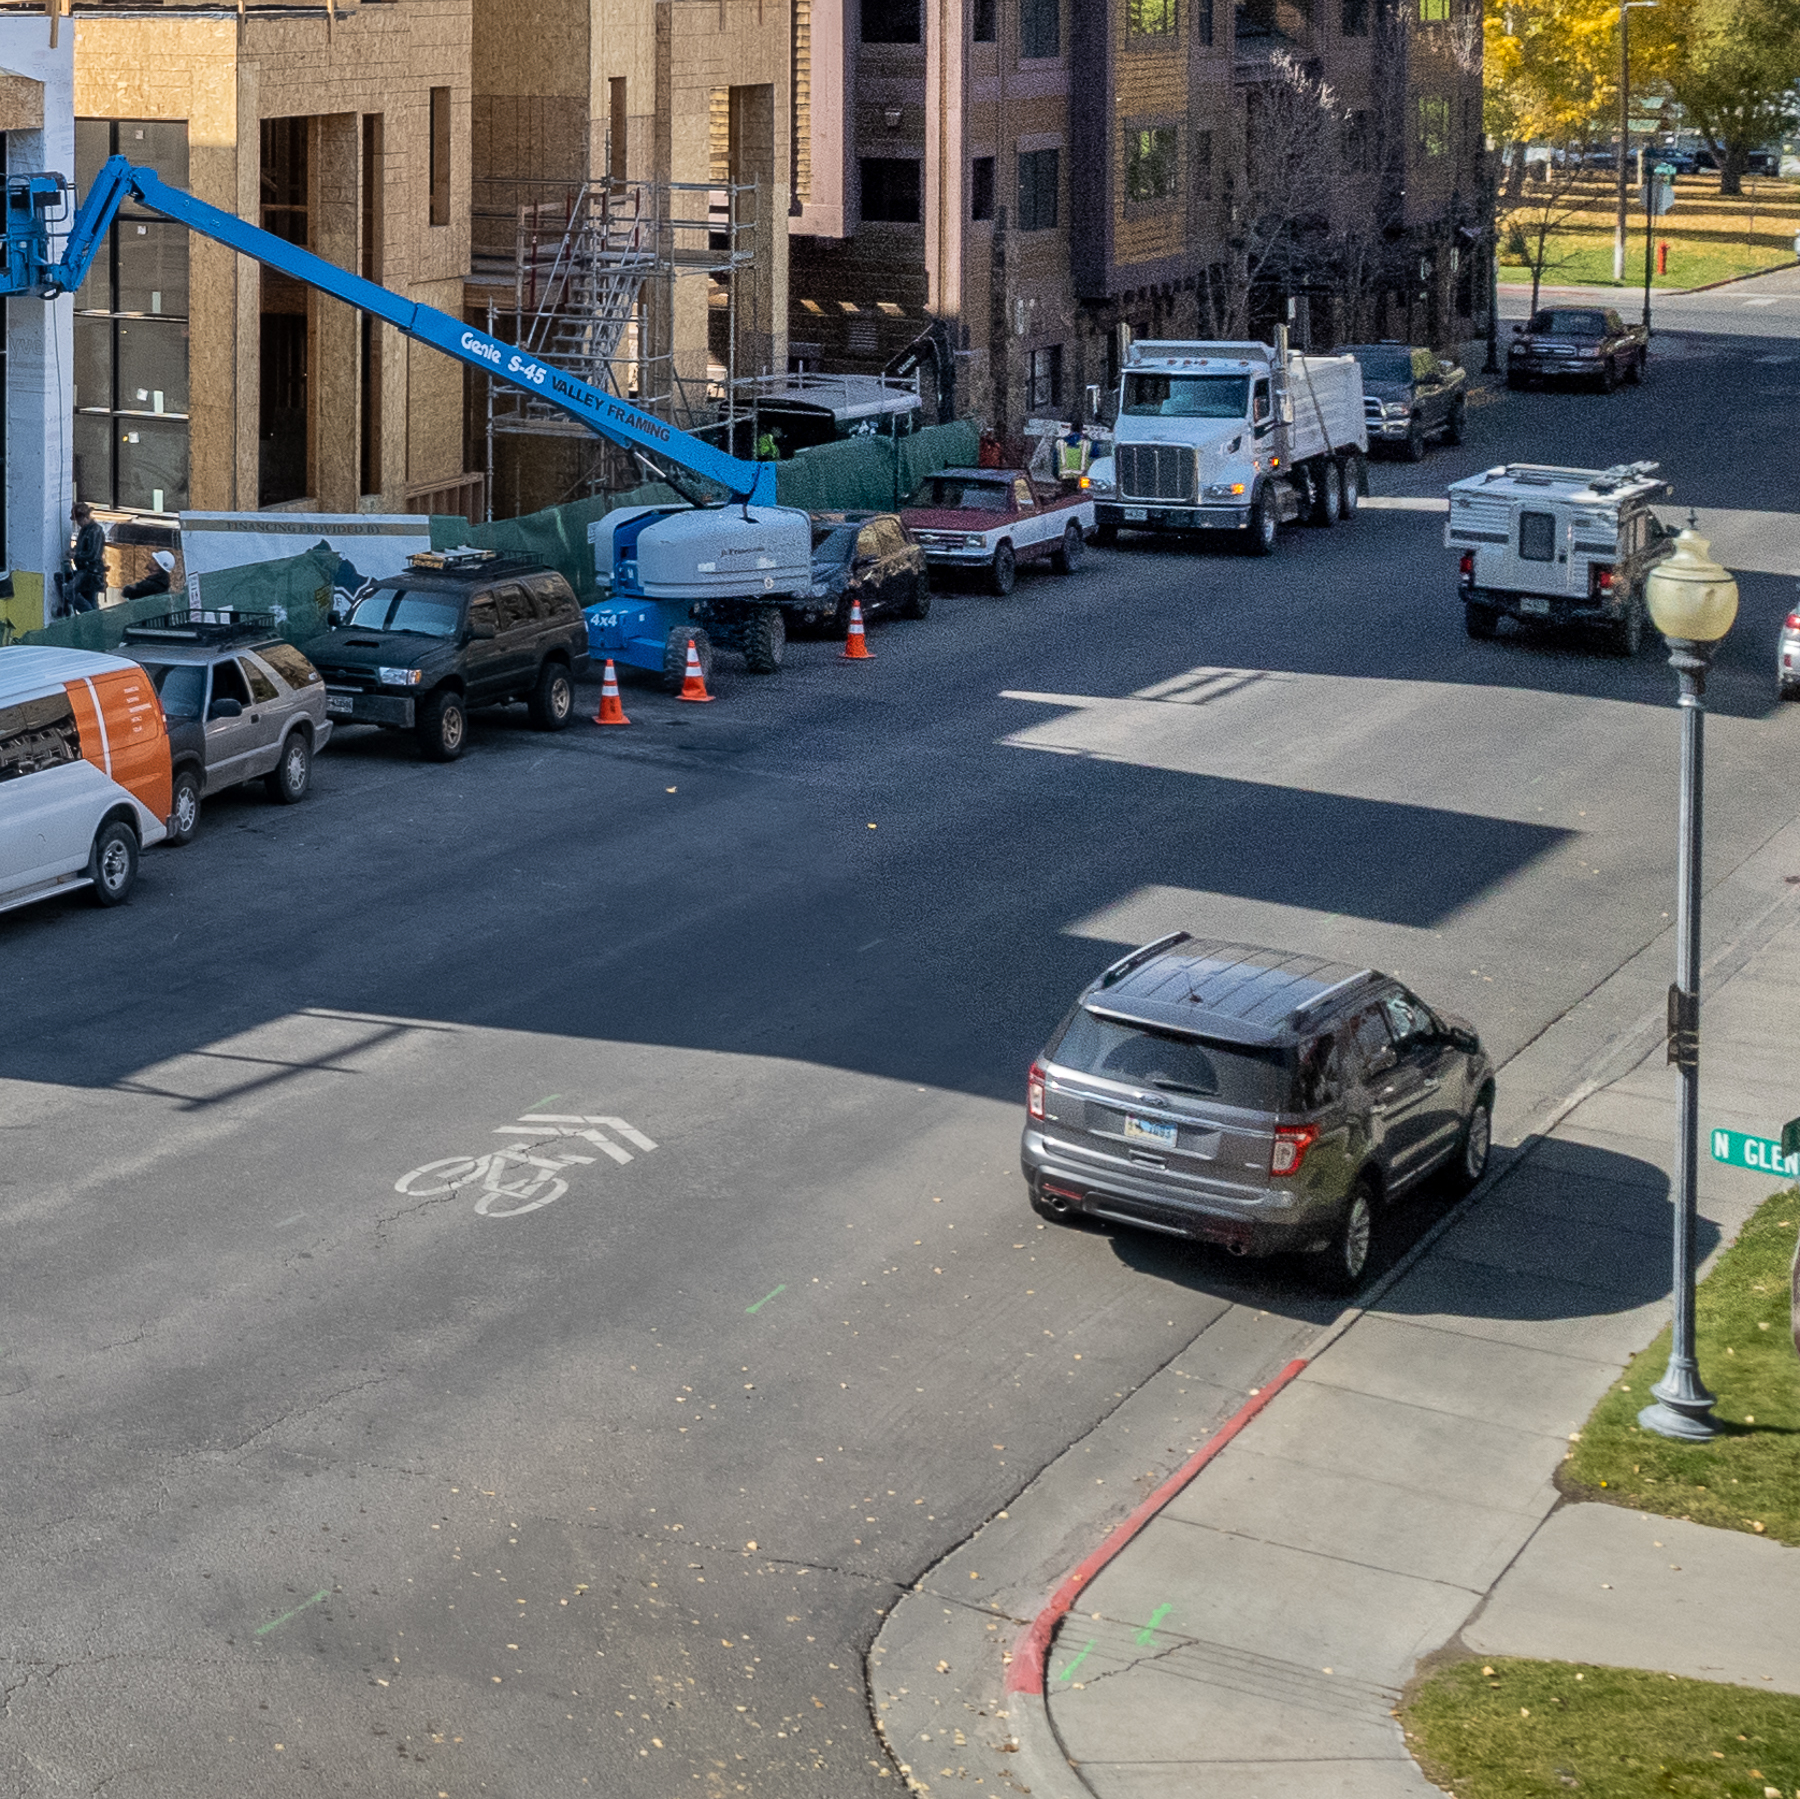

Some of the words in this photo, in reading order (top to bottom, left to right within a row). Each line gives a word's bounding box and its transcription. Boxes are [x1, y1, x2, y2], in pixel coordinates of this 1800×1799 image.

[461, 332, 501, 364] Genie
[508, 355, 547, 384] S-45
[551, 376, 605, 411] VALLEY
[607, 403, 670, 442] FRAMING
[227, 522, 296, 533] FINANCING
[299, 523, 362, 534] PROVIDED
[367, 524, 380, 535] BY
[590, 613, 618, 627] 4x4
[1714, 1131, 1729, 1158] N
[1744, 1138, 1798, 1175] GLEN
